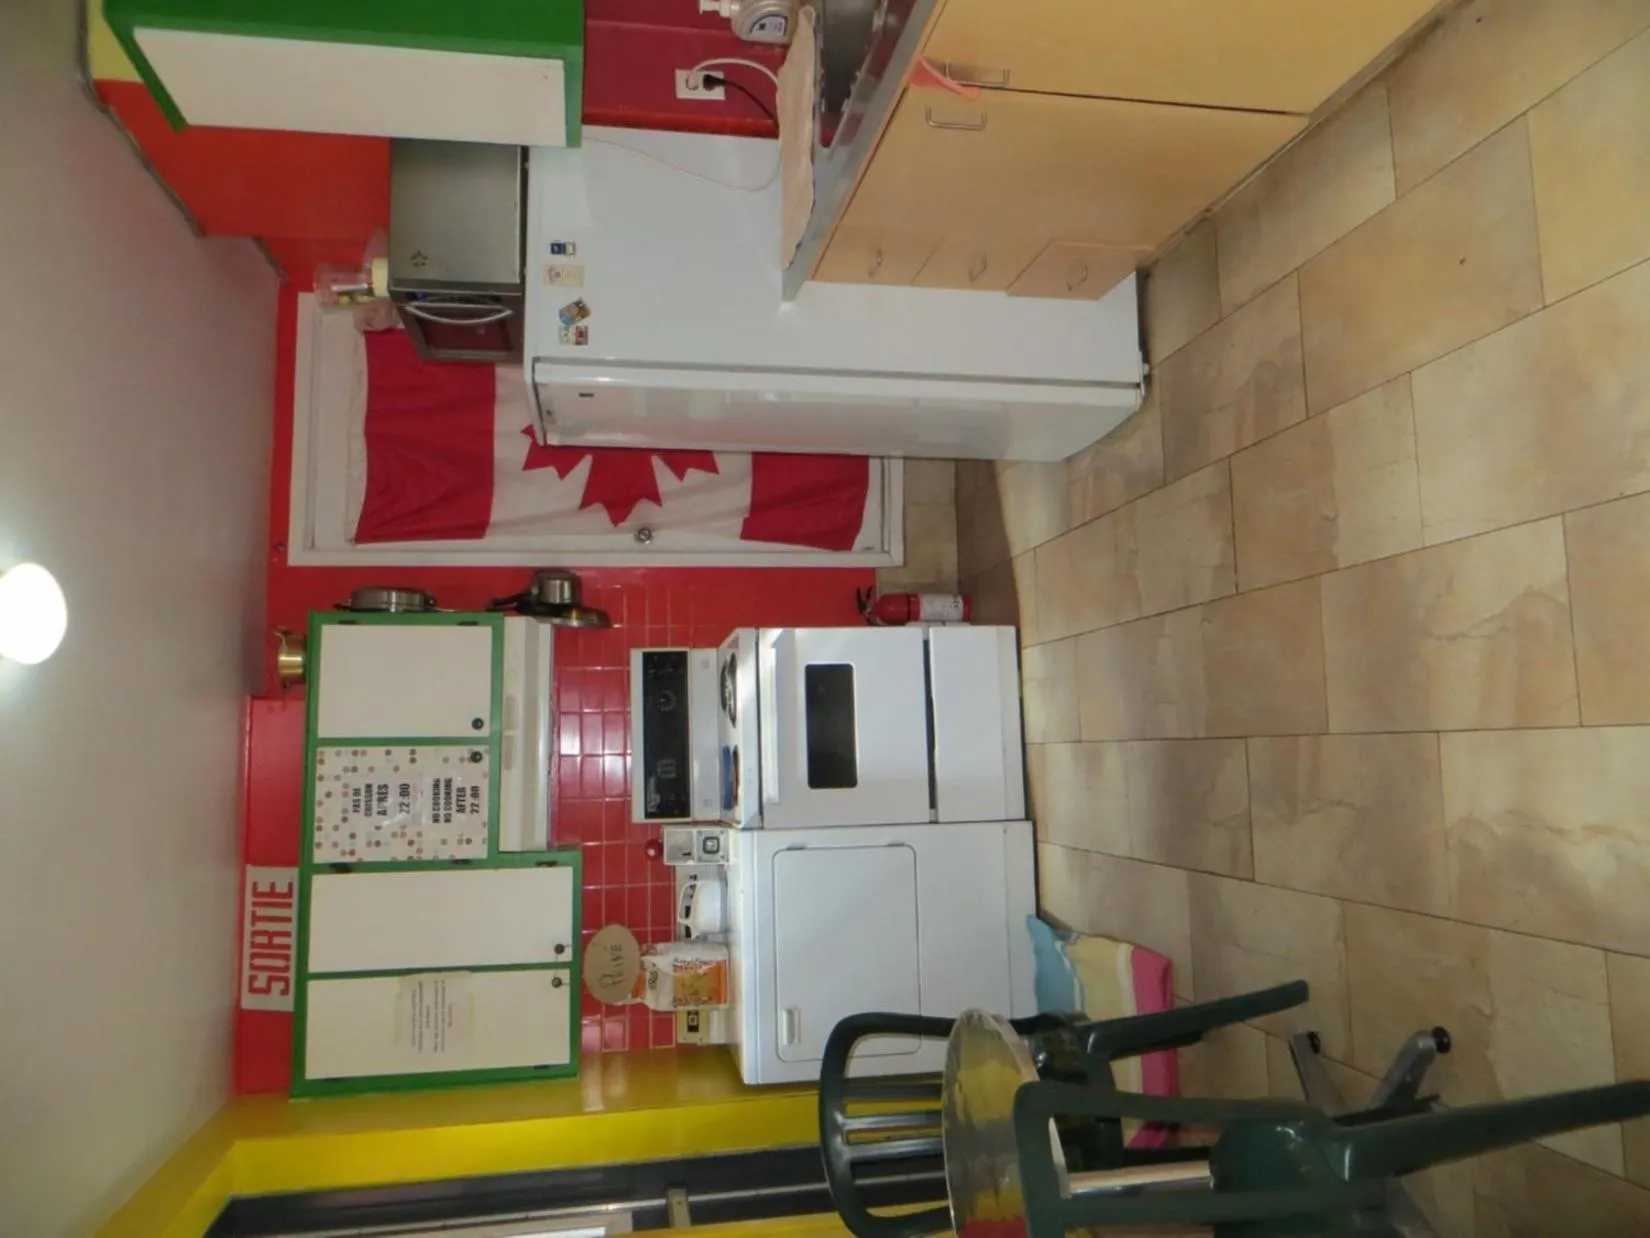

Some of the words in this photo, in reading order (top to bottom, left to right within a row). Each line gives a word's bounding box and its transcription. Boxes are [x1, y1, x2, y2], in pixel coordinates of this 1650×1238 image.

[352, 788, 361, 797] DE
[352, 798, 361, 814] PAS
[364, 783, 373, 817] CUISSON
[376, 783, 389, 816] APRÈS
[432, 778, 441, 812] COOKING
[444, 777, 453, 812] COOKING
[456, 787, 467, 814] AFTER
[432, 813, 440, 823] NO
[444, 813, 452, 823] NO
[247, 881, 293, 996] SORTIE
